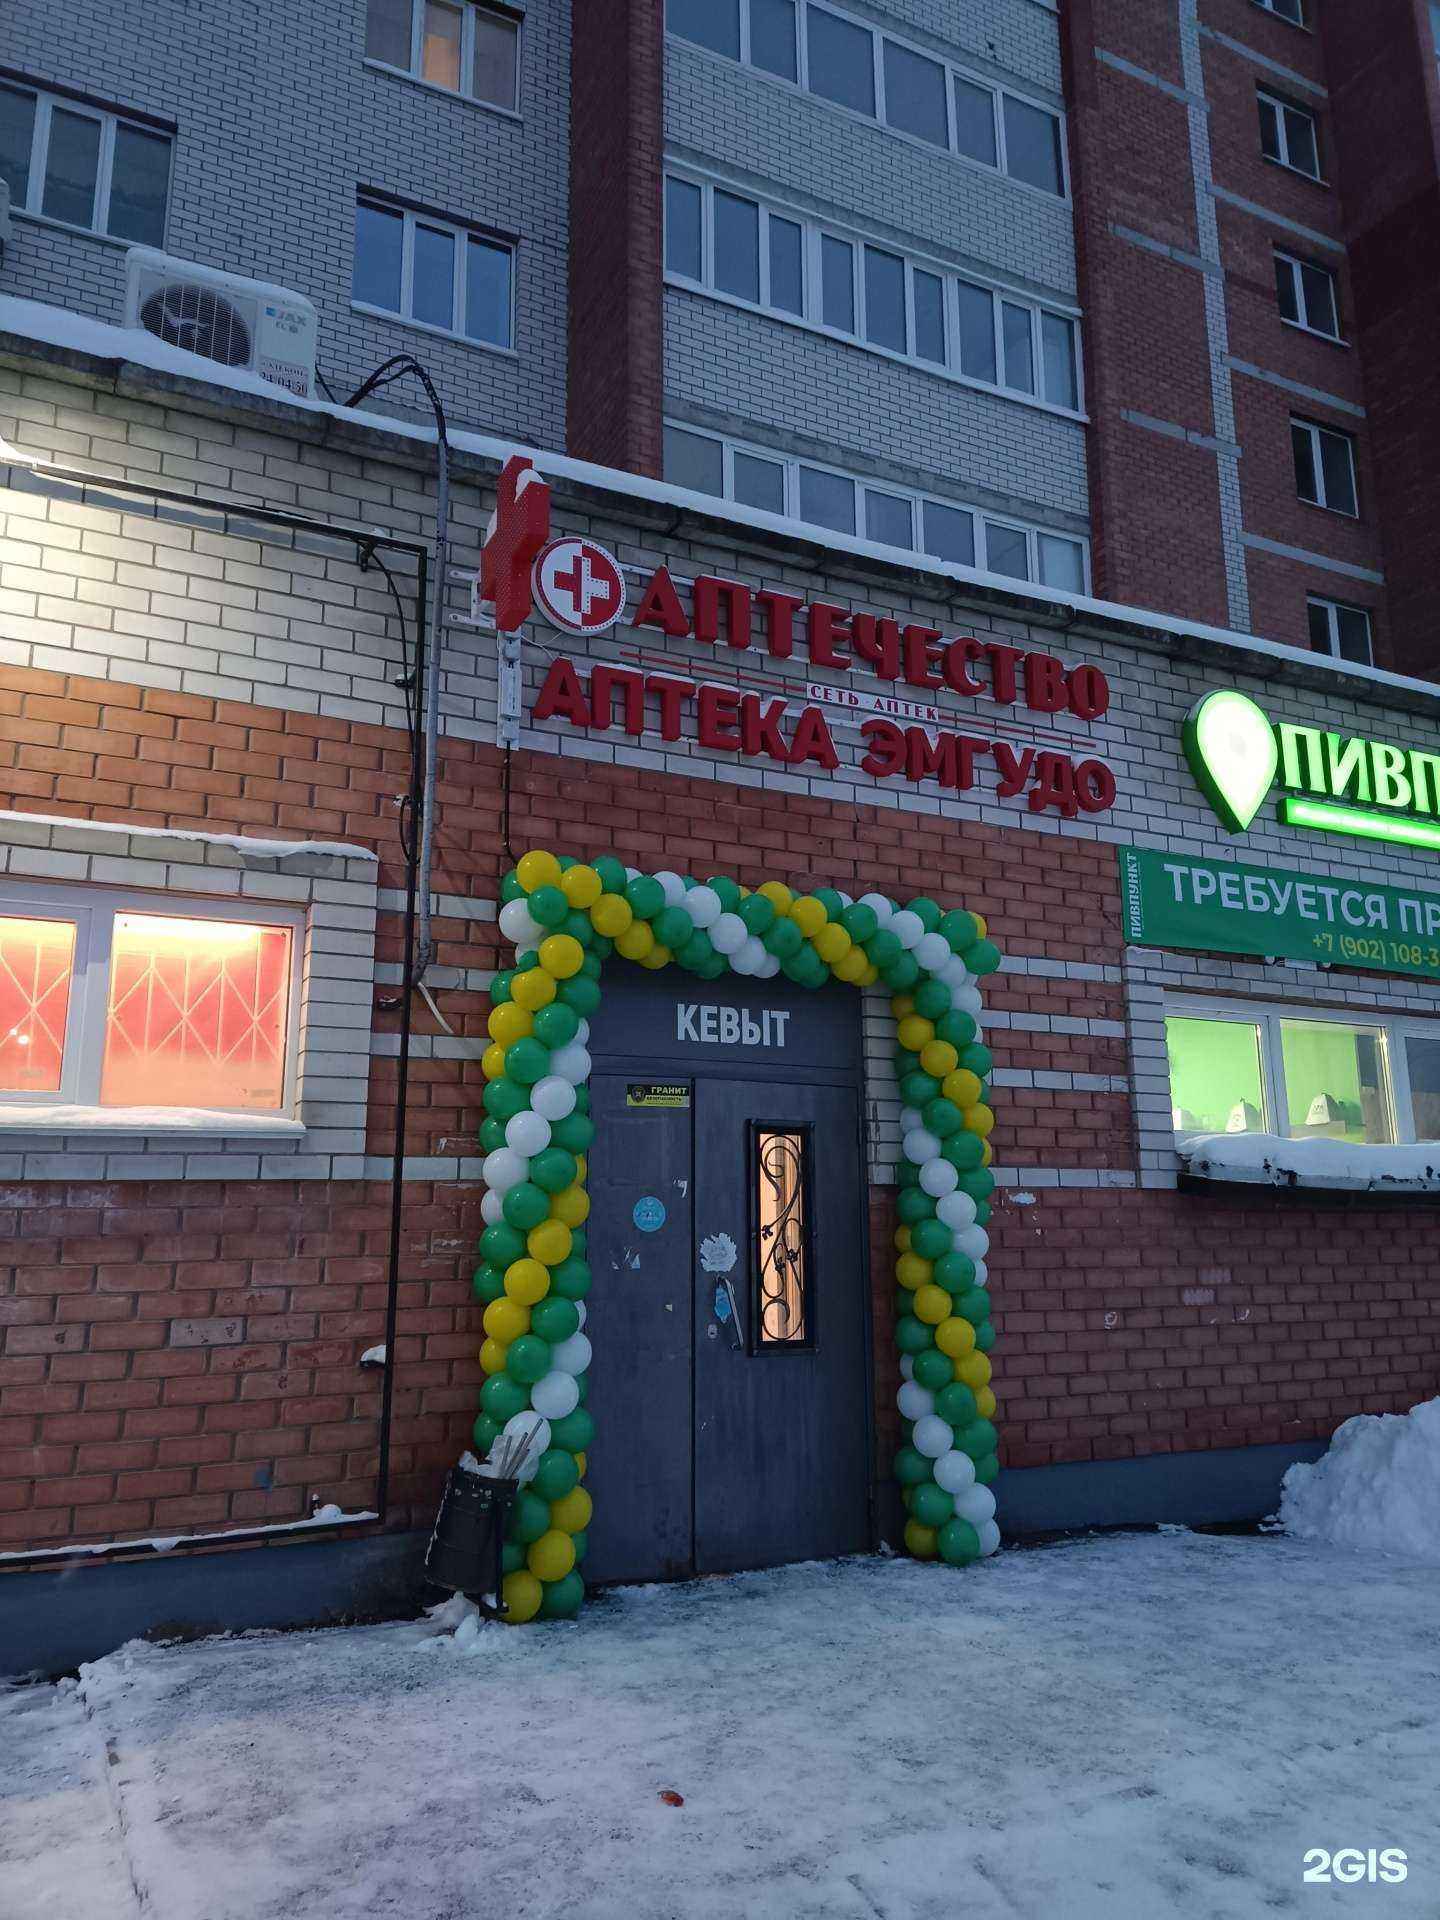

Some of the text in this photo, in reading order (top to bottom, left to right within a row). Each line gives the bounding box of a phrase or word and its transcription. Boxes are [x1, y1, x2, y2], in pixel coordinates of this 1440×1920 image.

[631, 566, 1109, 721] АПТЕЧЕСТВО
[810, 685, 937, 720] СЕТЬ АПТЕК
[532, 657, 1117, 818] АПТЕКА ЭМГУДО
[1276, 722, 1440, 816] ПИВП
[1127, 852, 1142, 938] ПИВПУНКТ
[1164, 864, 1389, 930] ТРЕБУЕТСЯ
[1312, 932, 1333, 952] +7
[1340, 934, 1386, 965] (902)
[677, 1003, 790, 1048] КЕВЫТ
[651, 1086, 687, 1095] ГРАНИТ
